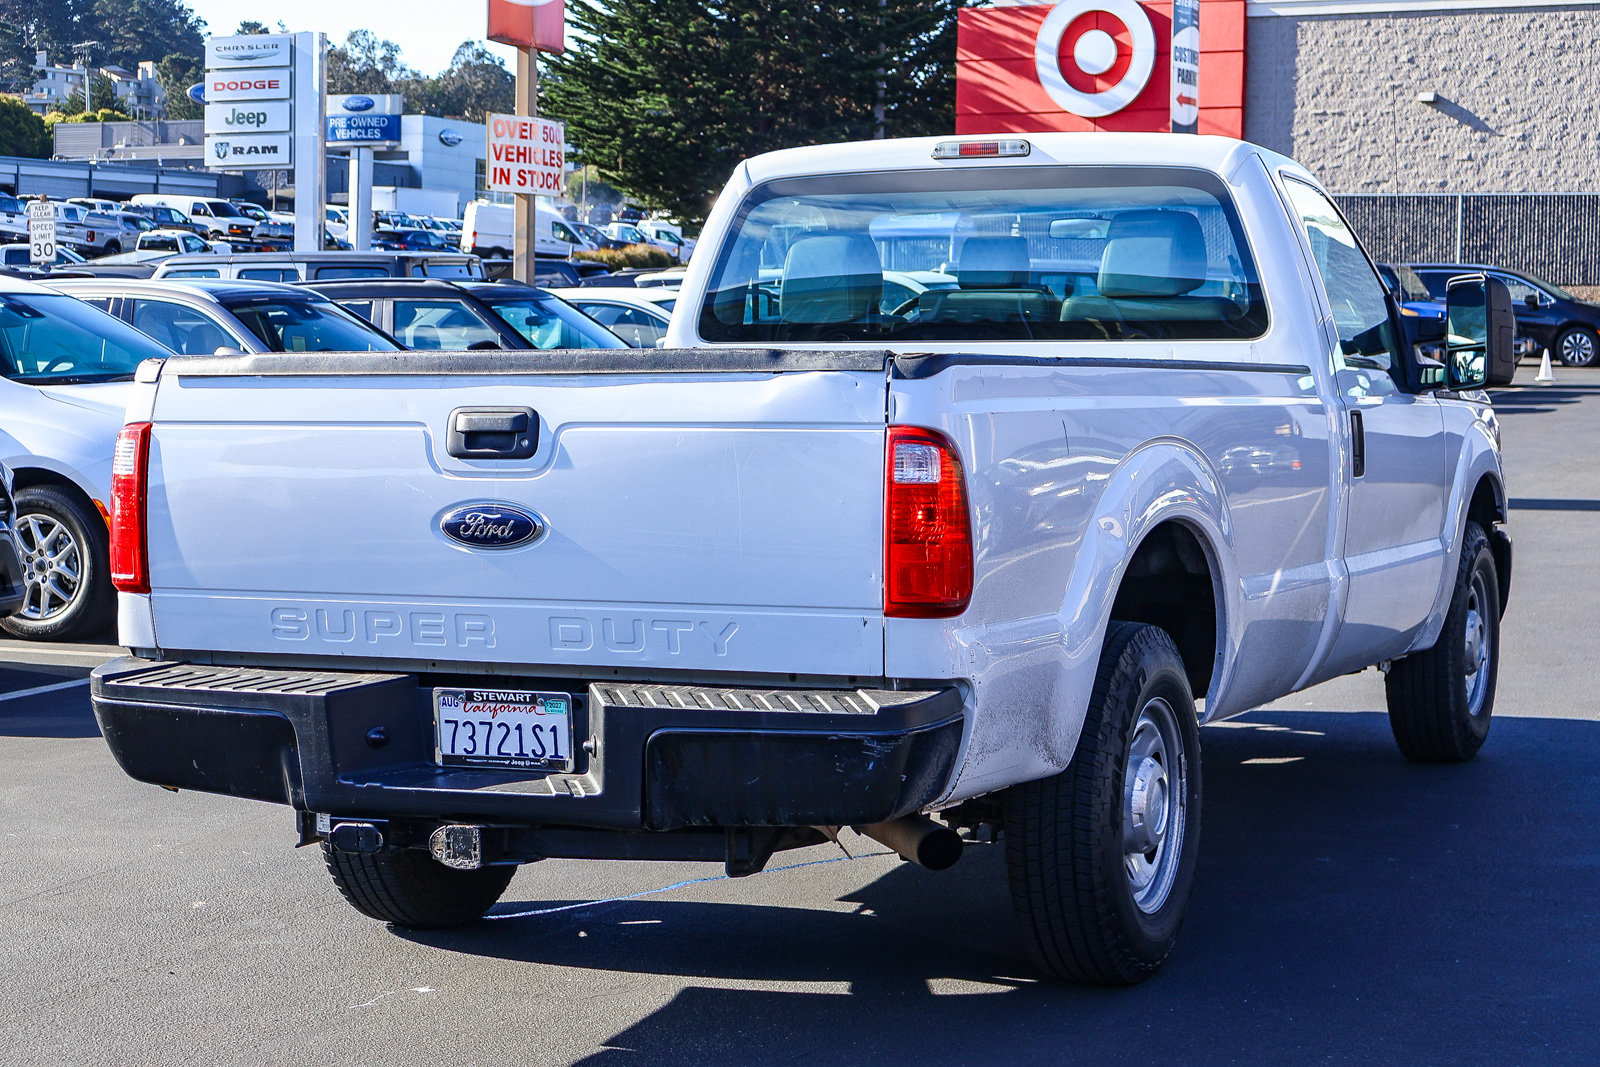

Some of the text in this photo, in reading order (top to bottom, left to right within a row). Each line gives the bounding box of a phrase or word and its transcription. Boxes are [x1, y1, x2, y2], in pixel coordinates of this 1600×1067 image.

[215, 43, 279, 52] CHRYSLER
[214, 80, 280, 91] DODGE
[225, 108, 267, 127] Jeep
[335, 128, 381, 139] VEHICLES
[493, 118, 562, 145] OVER 500
[232, 145, 279, 155] RAM
[492, 143, 563, 169] VEHICLES
[493, 167, 561, 191] IN STOCK
[32, 223, 54, 231] SPEED
[33, 242, 54, 257] 30
[460, 512, 515, 539] Ford
[270, 607, 739, 656] SUPER DUTY
[473, 691, 532, 702] STEWART
[441, 696, 459, 708] AUG
[463, 702, 546, 719] California
[444, 719, 564, 759] 73721S1
